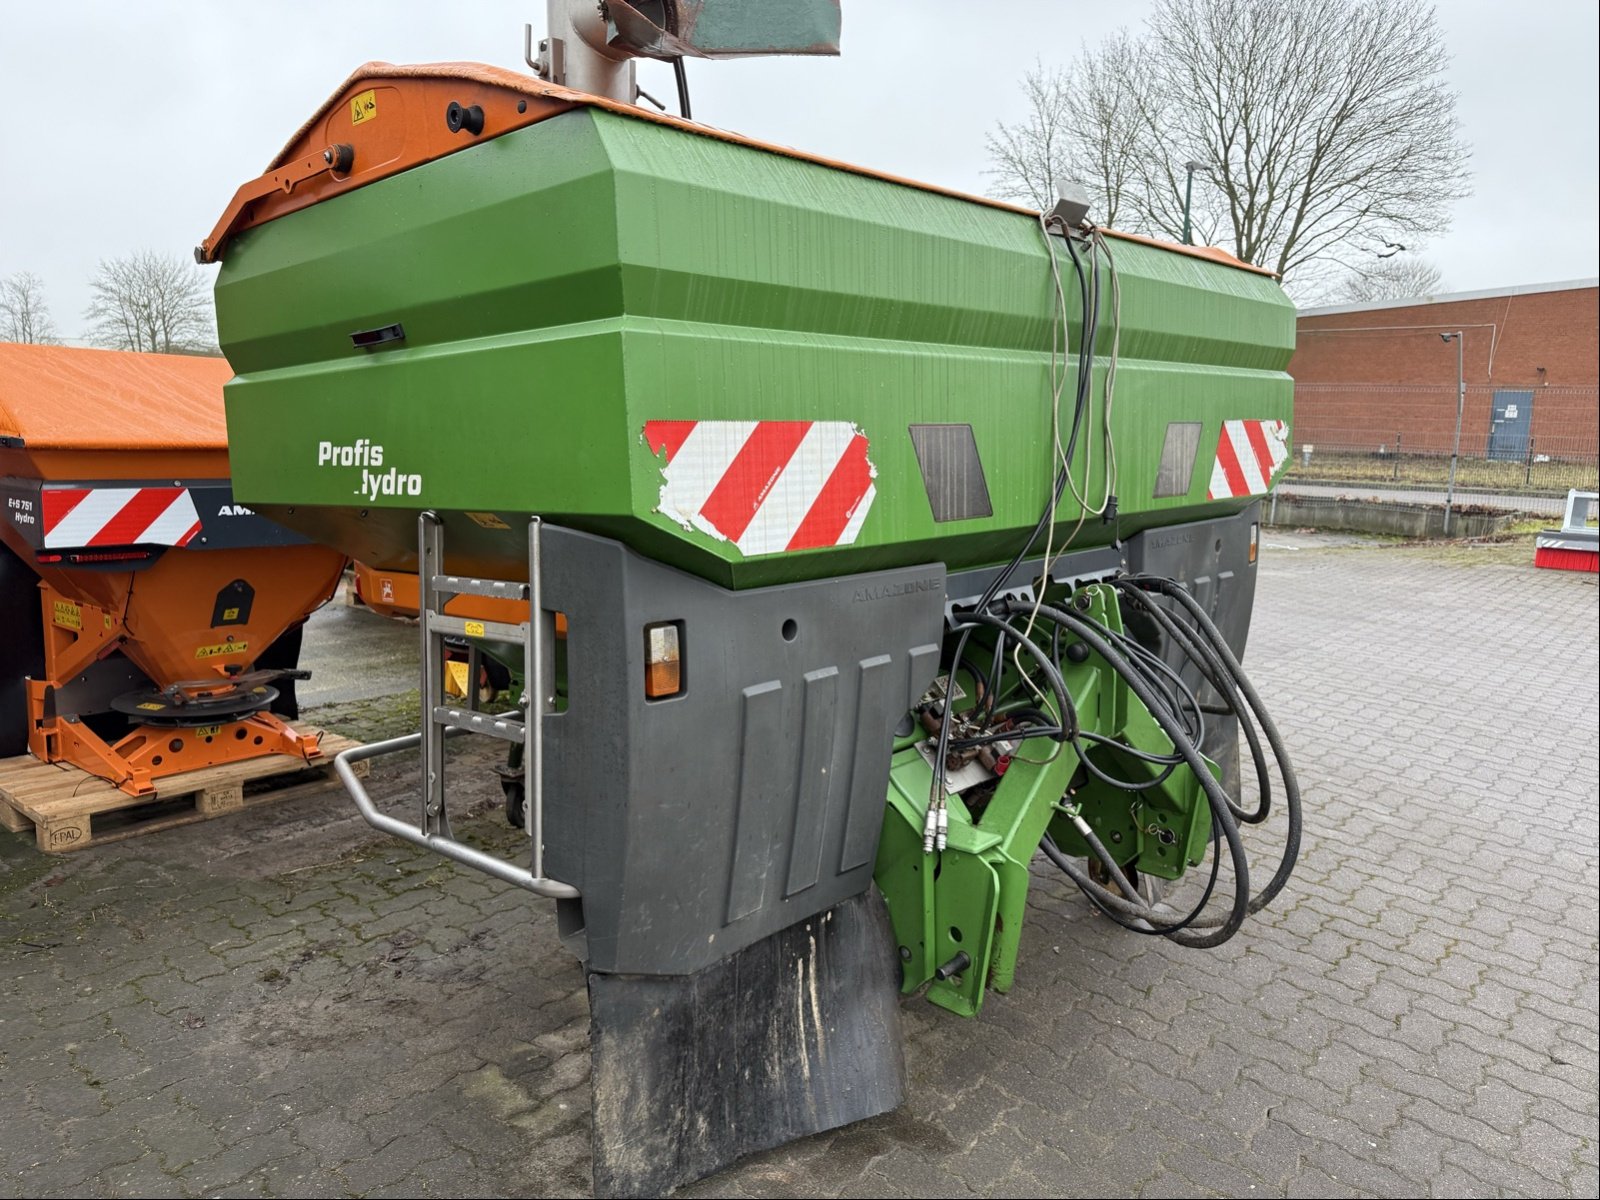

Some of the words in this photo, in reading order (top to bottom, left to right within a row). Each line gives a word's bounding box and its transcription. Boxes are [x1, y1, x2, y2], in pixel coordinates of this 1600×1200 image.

[318, 439, 384, 467] Profis
[8, 497, 20, 509] E+S
[21, 500, 33, 511] 751
[218, 505, 255, 516] AM
[15, 512, 35, 525] Hydro
[852, 578, 942, 604] AMAZONE
